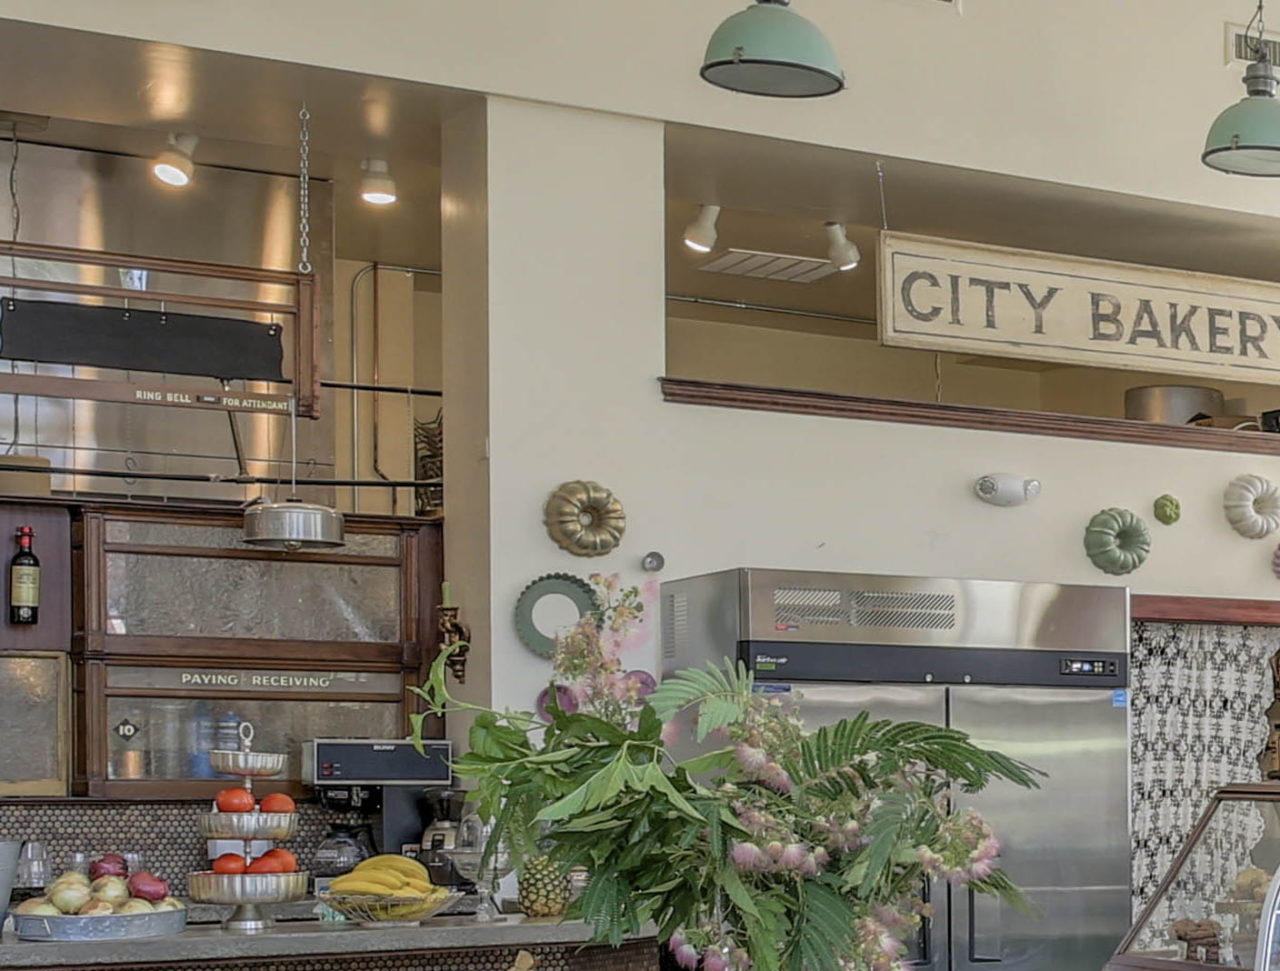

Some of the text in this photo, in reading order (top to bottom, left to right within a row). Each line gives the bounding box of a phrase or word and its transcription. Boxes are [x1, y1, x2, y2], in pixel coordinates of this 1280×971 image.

[900, 271, 1063, 334] CITY
[136, 390, 288, 410] RING BELL FOR ATTENDANT
[181, 673, 330, 687] PAYING RECEIVING
